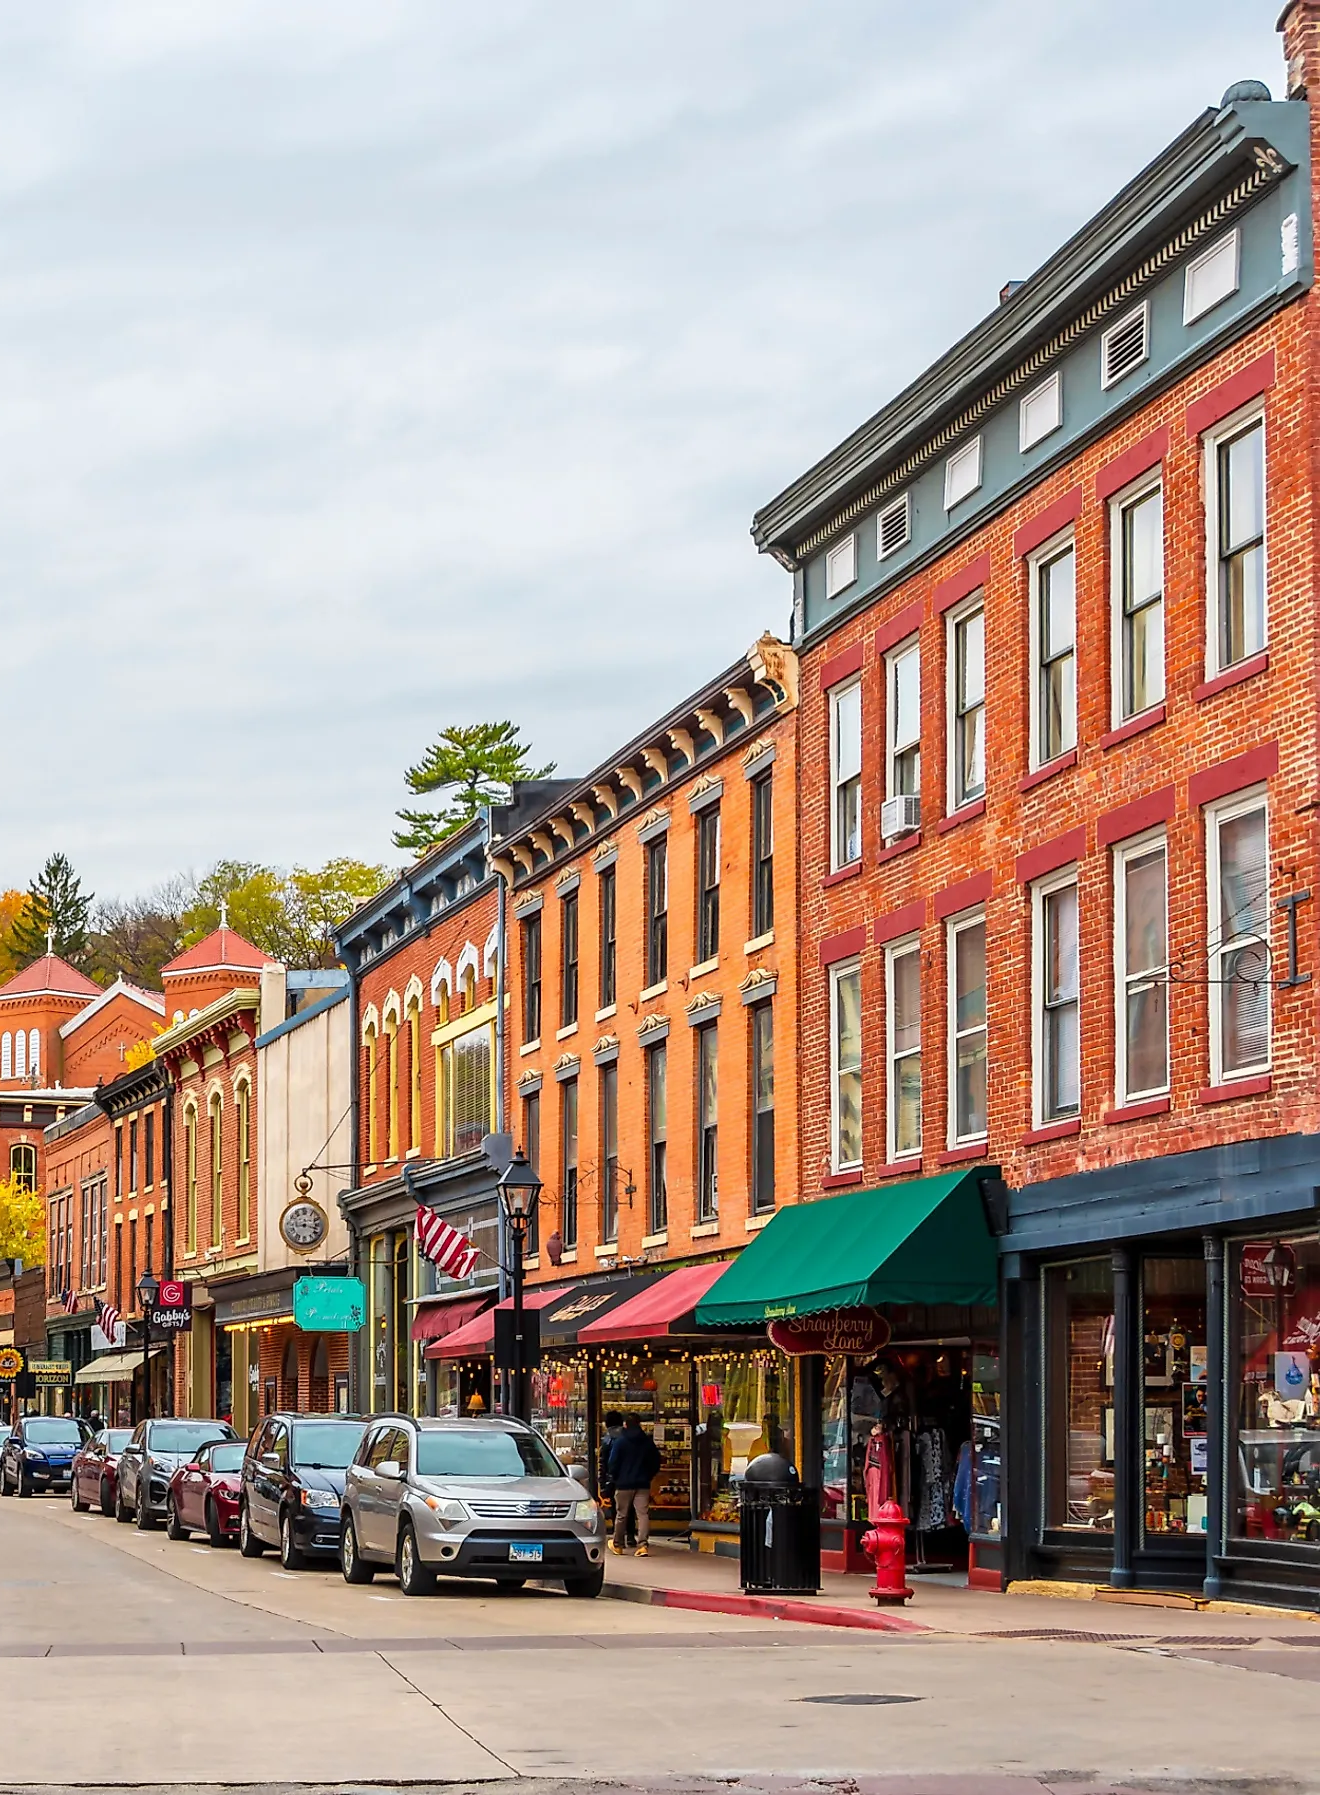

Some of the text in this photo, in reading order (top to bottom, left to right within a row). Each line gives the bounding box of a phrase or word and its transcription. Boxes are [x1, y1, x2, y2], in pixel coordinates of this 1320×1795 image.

[152, 1308, 192, 1328] Gabby's
[161, 1320, 180, 1328] GIFTS
[788, 1309, 874, 1340] Strawberry
[823, 1331, 865, 1350] Lane
